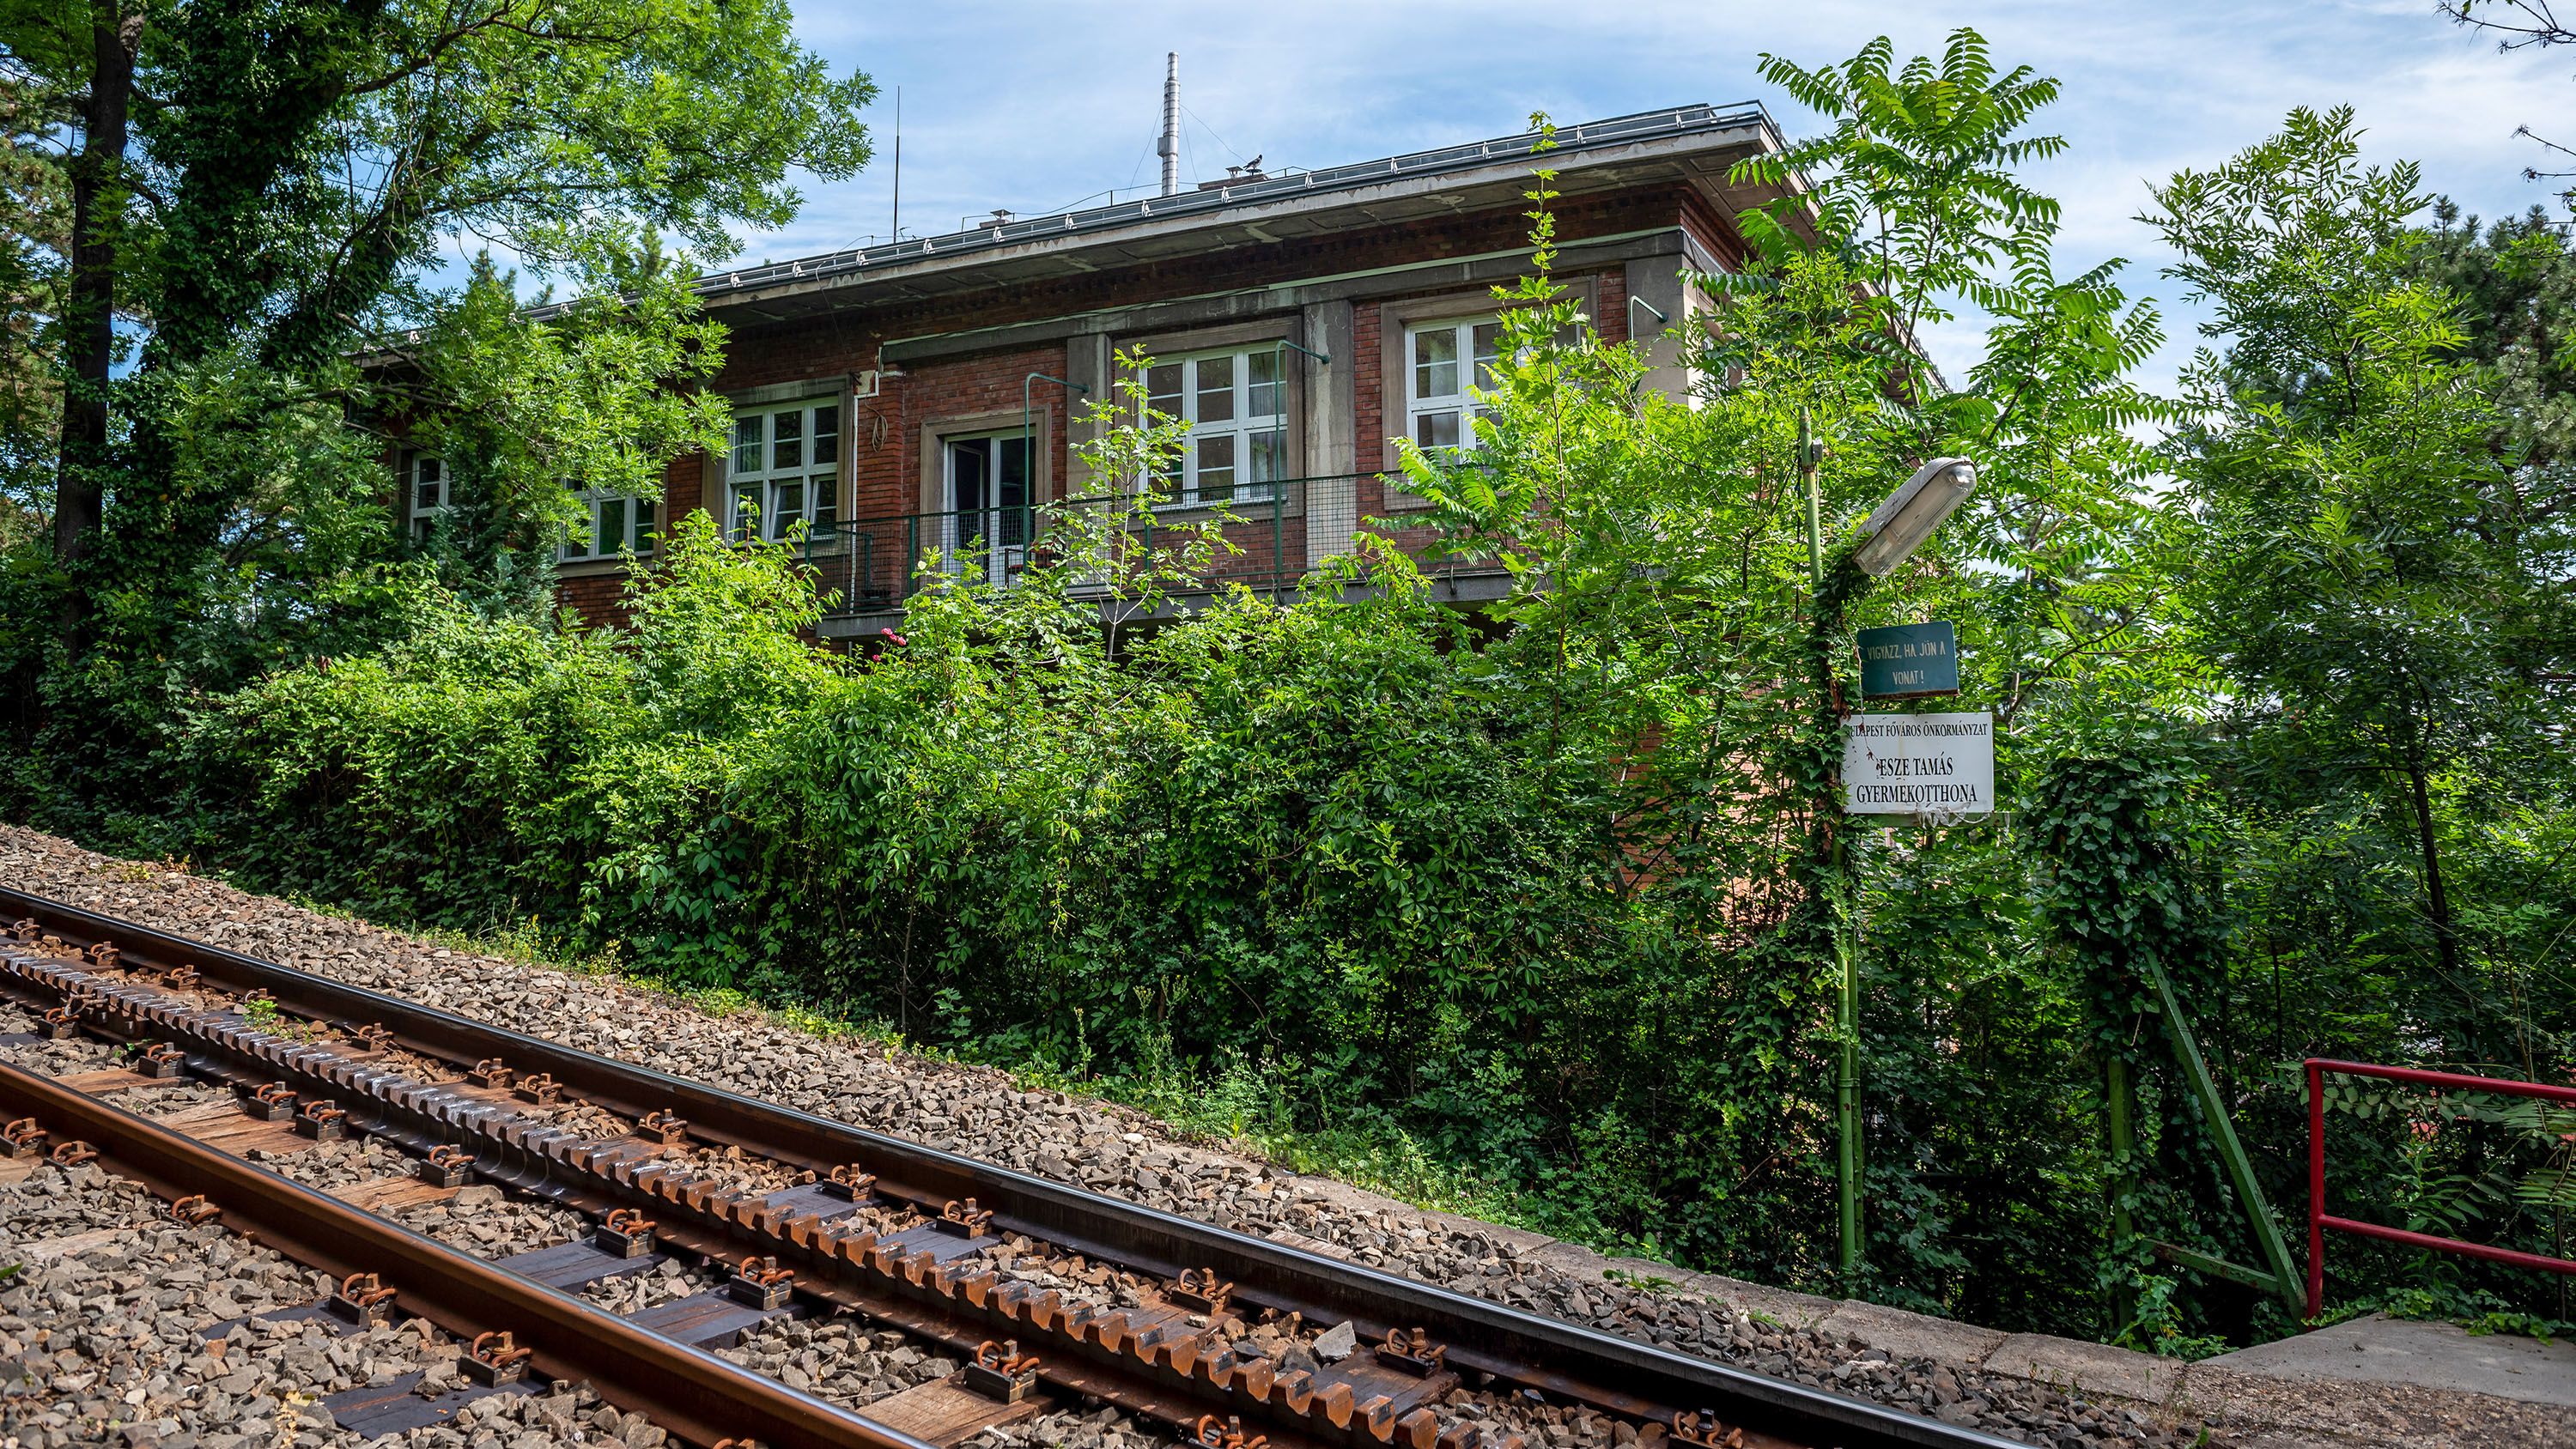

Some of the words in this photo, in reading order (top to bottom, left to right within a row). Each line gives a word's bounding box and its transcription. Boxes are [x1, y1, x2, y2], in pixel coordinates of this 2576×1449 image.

[1867, 643, 1902, 660] VIGYÁZZ,
[1904, 643, 1917, 658] HA
[1919, 640, 1937, 657] JÖN
[1940, 640, 1946, 655] A
[1886, 721, 1921, 737] FŐVÁROS
[1924, 719, 1988, 737] ÖNKORMÁNYZAT
[1880, 758, 1910, 776] ESZE
[1913, 751, 1953, 776] TAMÁS
[1856, 784, 1978, 803] GYERMEKOTTHONA
